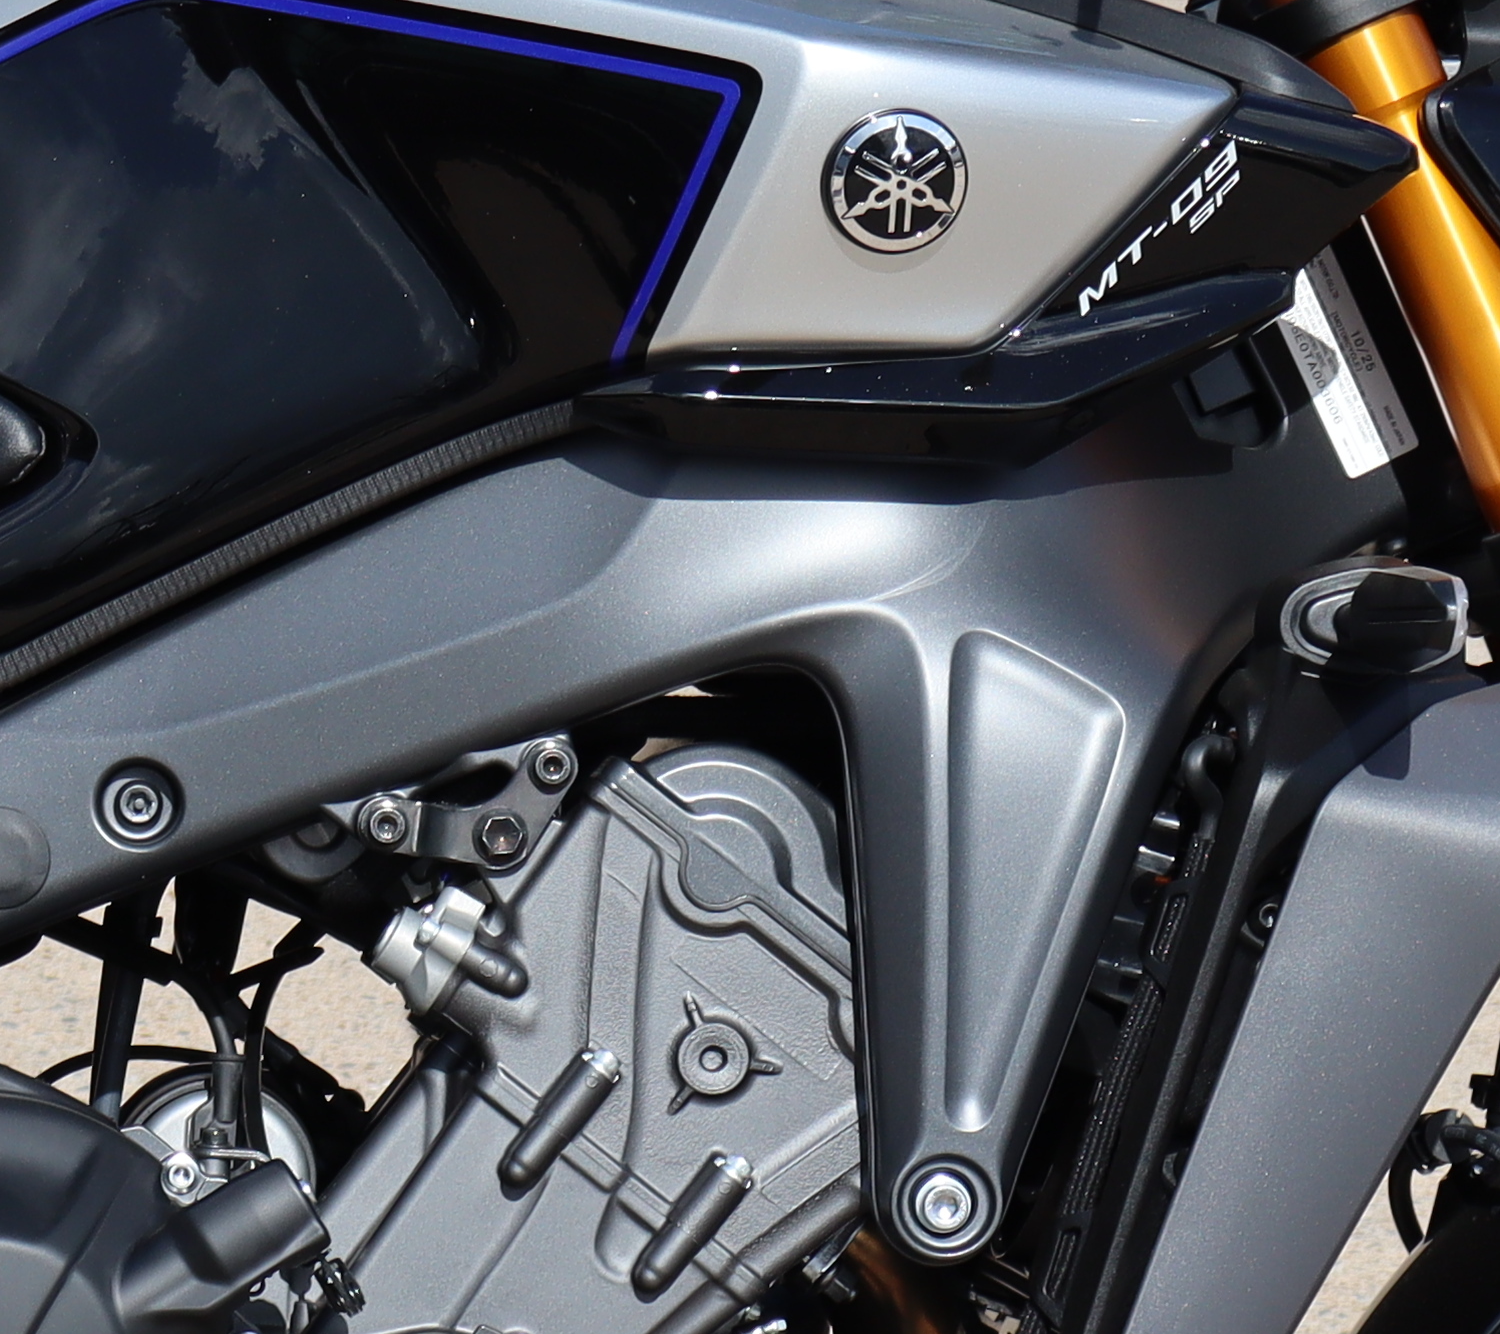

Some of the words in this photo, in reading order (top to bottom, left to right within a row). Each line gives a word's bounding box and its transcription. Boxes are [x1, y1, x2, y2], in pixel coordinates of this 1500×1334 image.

[1079, 140, 1238, 317] MT-09
[1189, 170, 1241, 235] SP
[1348, 329, 1379, 373] 10/25
